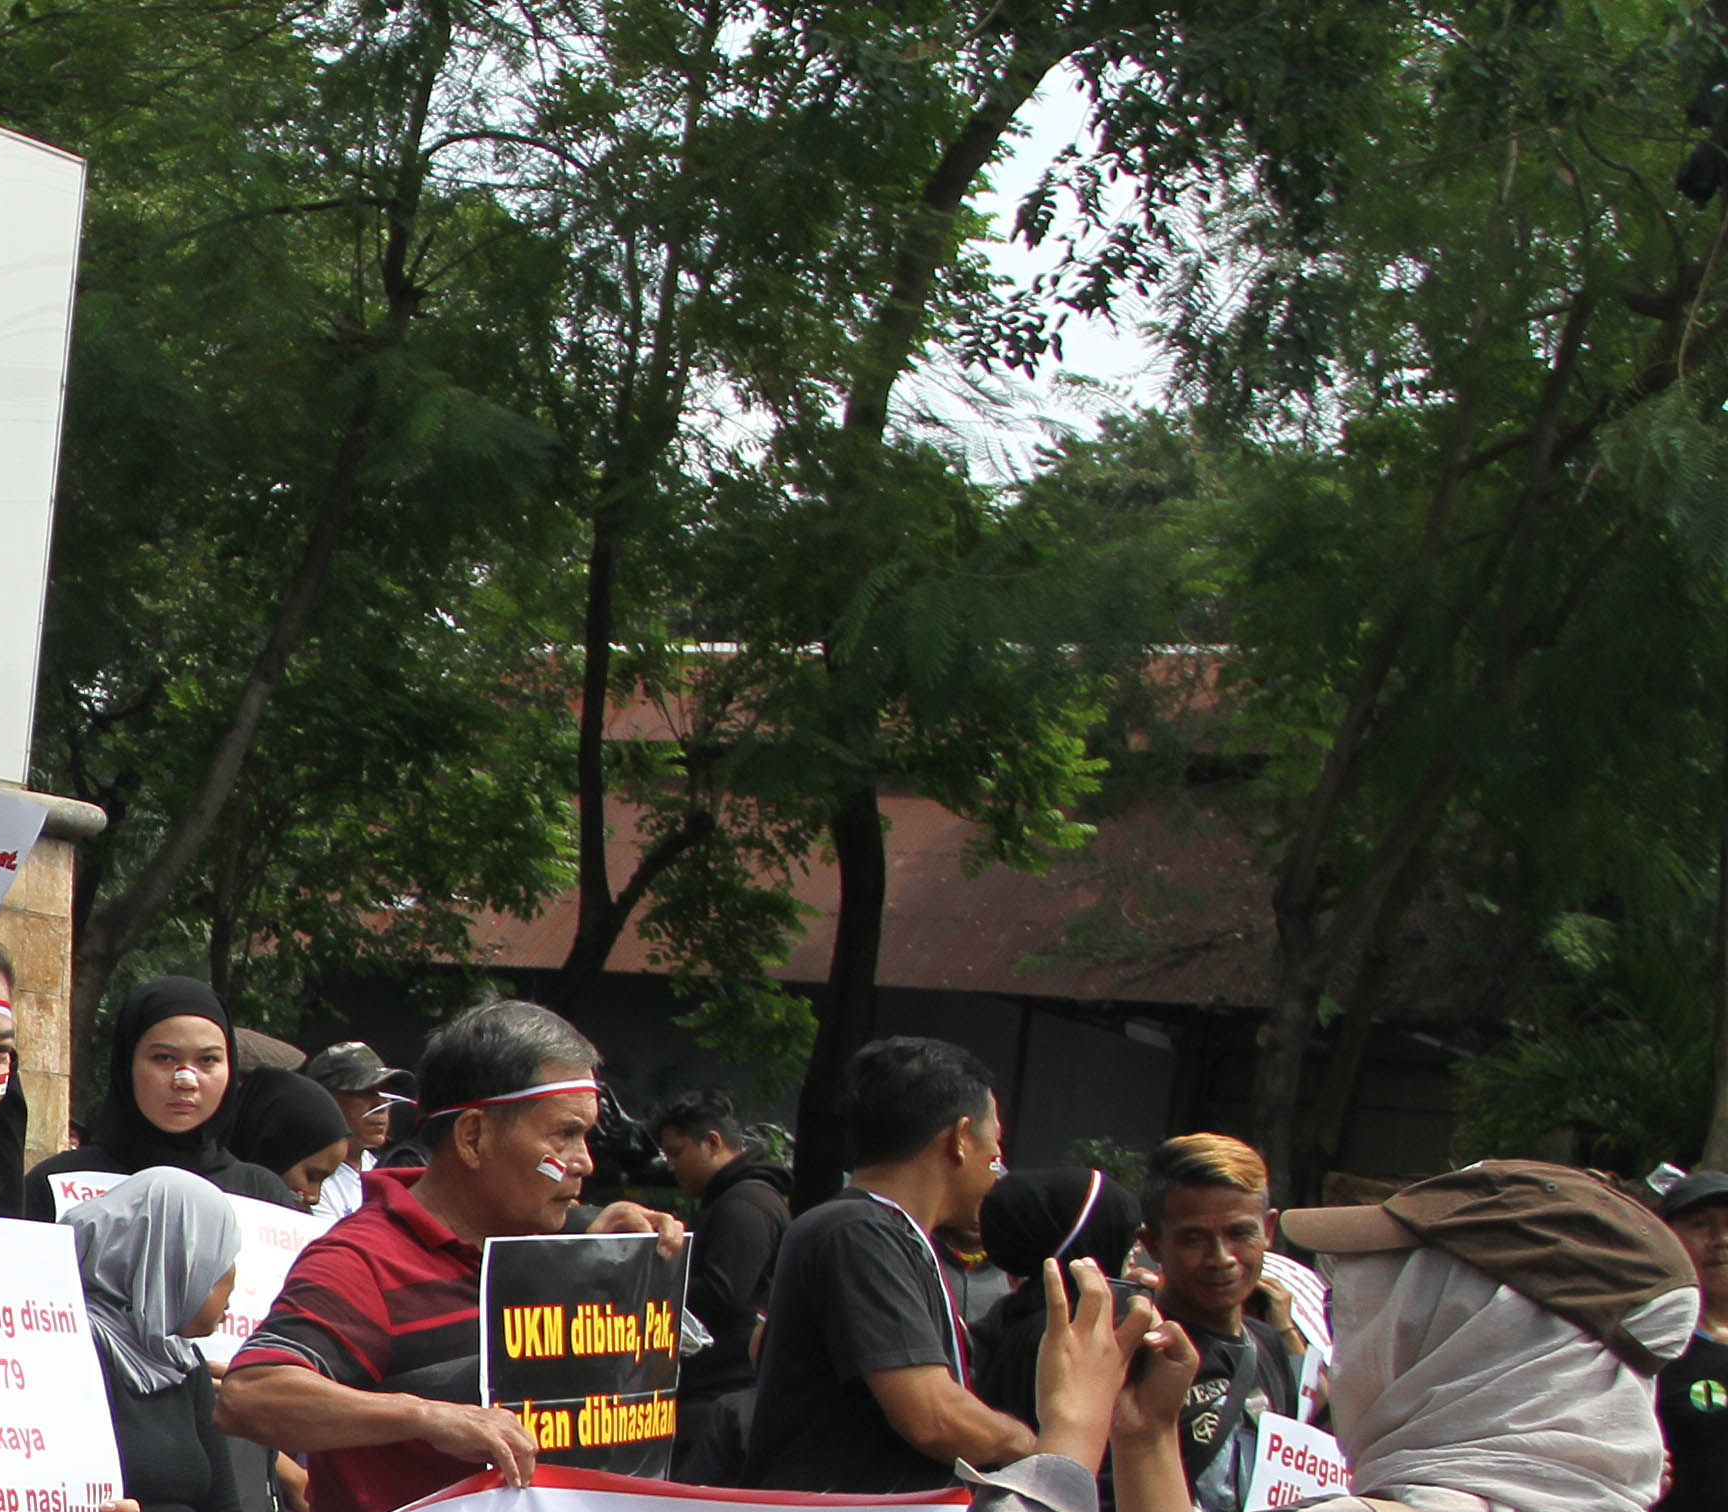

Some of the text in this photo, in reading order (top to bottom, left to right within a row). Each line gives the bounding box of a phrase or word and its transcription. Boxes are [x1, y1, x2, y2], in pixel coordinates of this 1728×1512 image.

[21, 1300, 78, 1334] disini
[502, 1300, 675, 1363] UKM dibina, Pak,
[576, 1389, 677, 1449] dibinasakan
